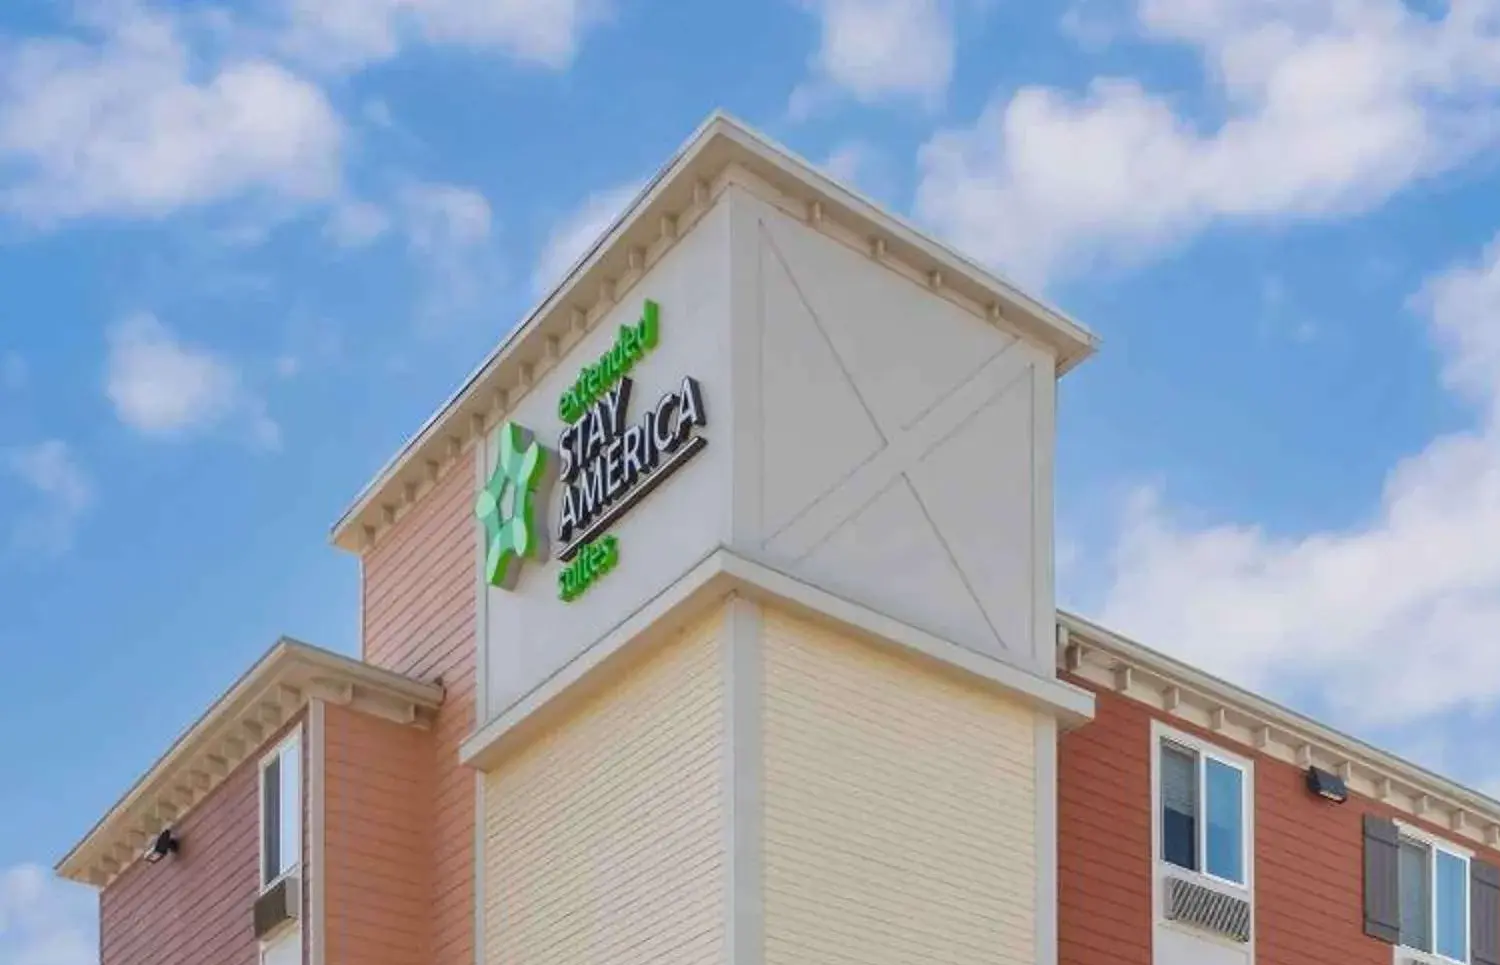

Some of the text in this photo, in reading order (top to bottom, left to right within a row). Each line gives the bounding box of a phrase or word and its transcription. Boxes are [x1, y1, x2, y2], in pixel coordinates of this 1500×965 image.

[559, 298, 659, 424] extended
[558, 376, 633, 482] STAY
[558, 375, 707, 542] AMERICA
[558, 535, 619, 603] suites
